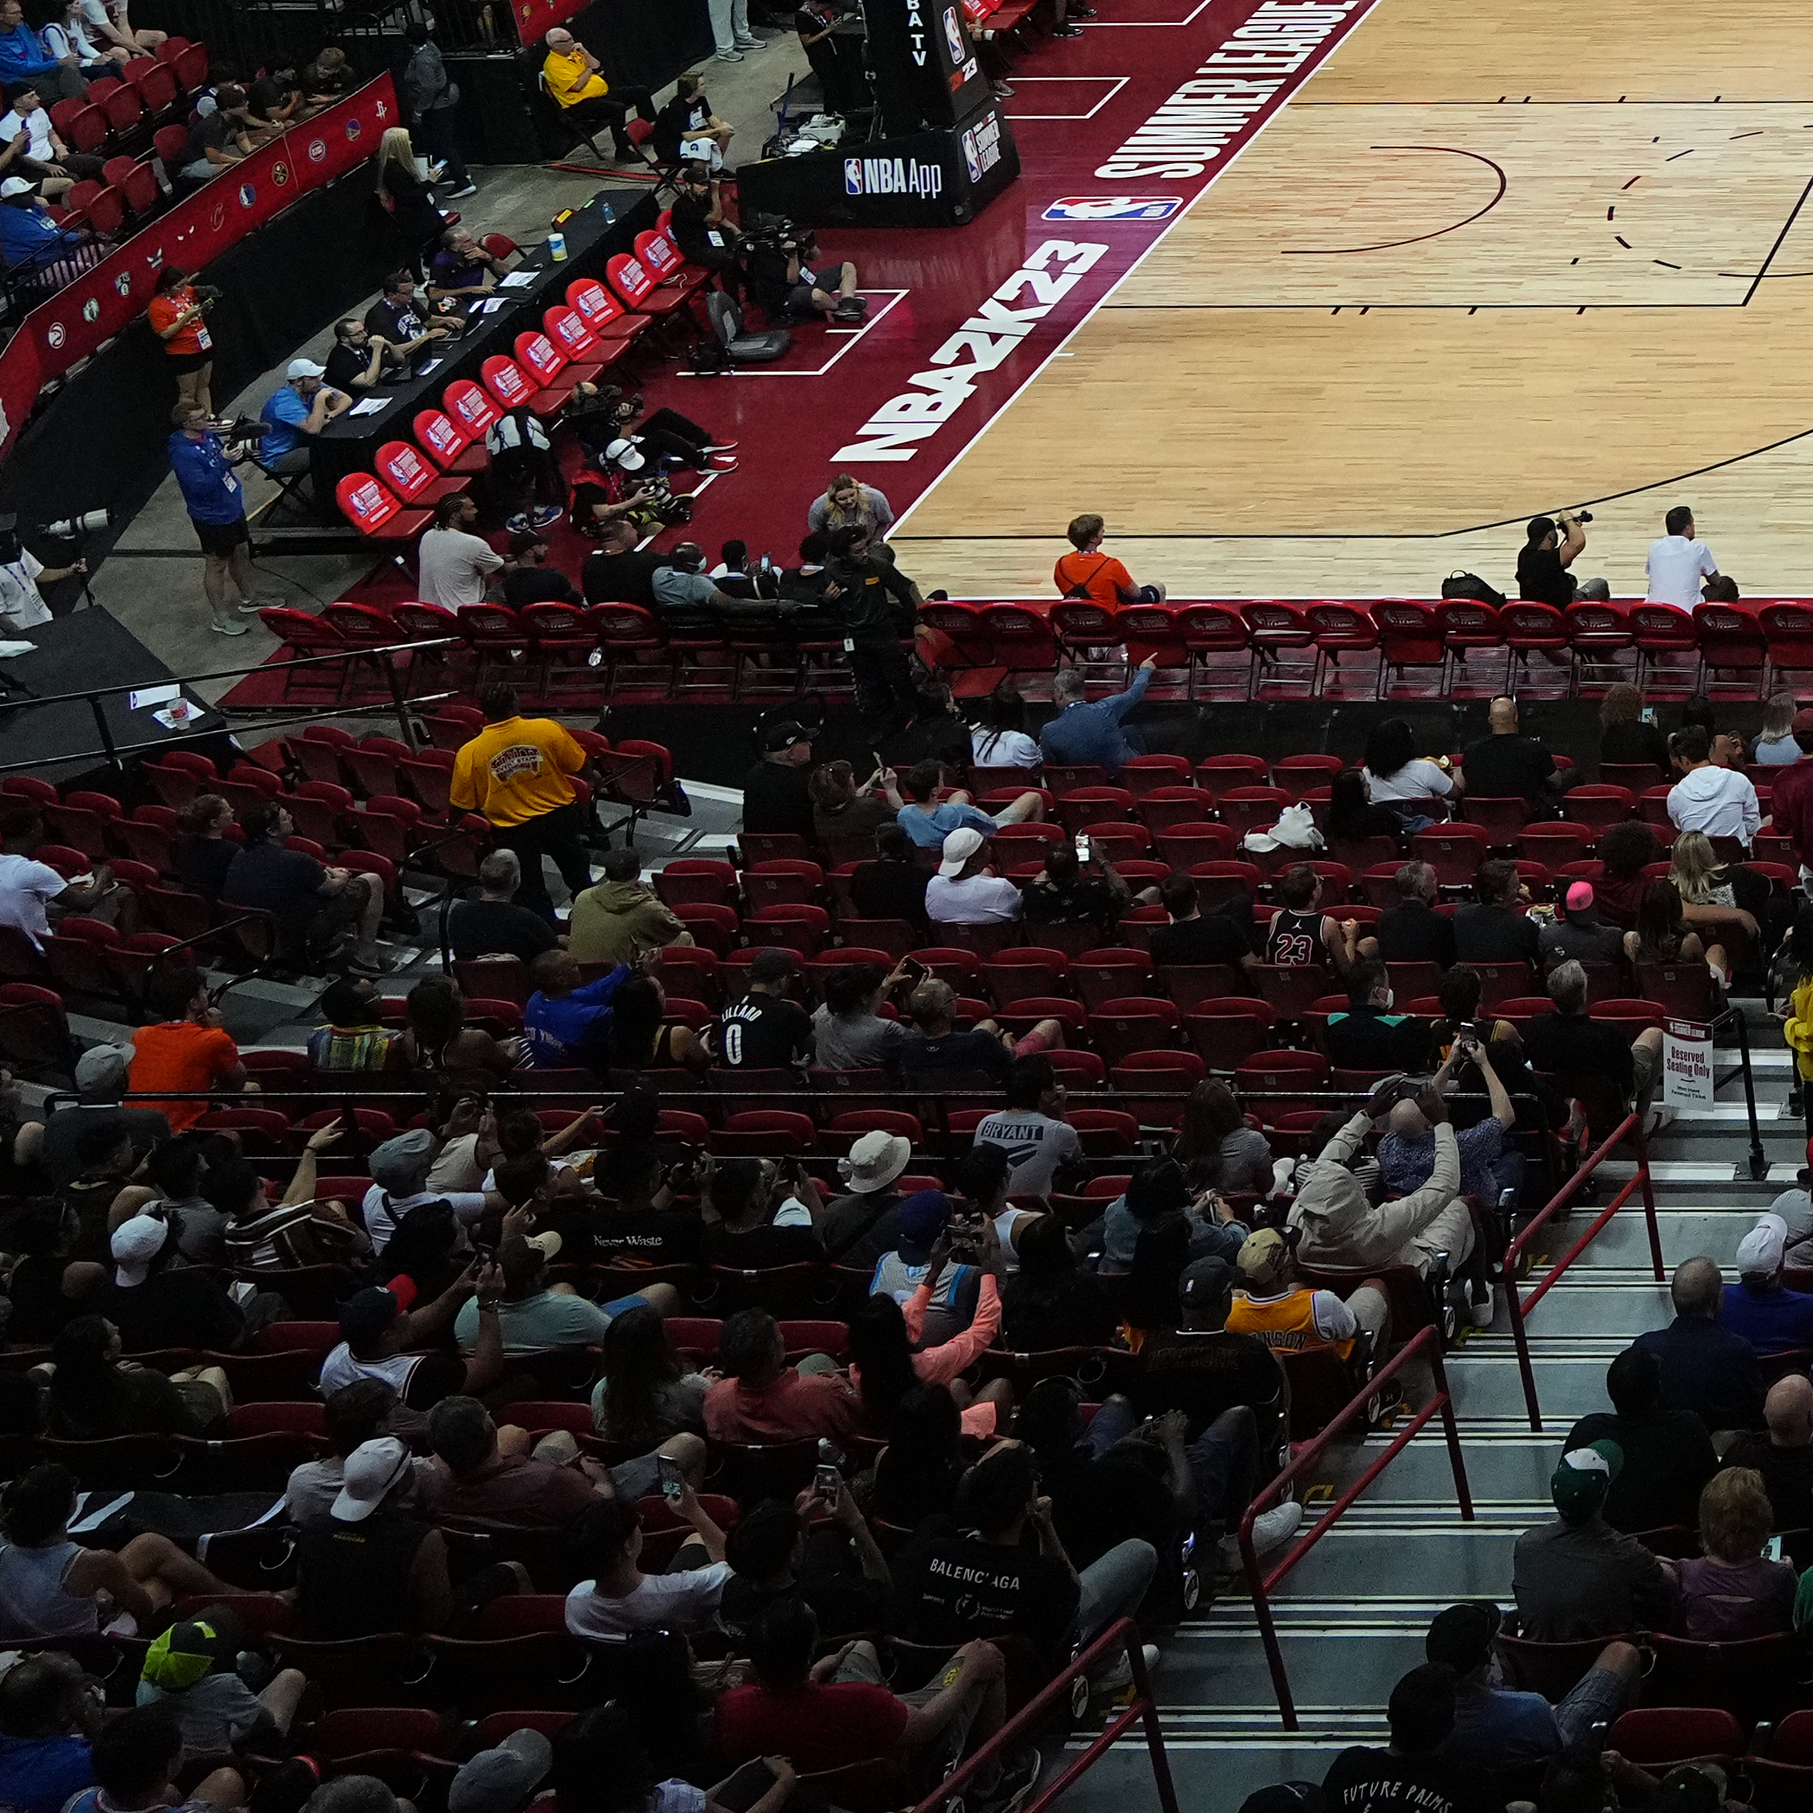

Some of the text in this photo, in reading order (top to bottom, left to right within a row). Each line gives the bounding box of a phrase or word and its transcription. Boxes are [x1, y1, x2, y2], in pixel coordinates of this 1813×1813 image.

[911, 35, 926, 67] TV
[1095, 0, 1358, 180] SUMMER LEAGUE
[975, 119, 1001, 154] SUMMER
[979, 140, 1002, 174] LEAGUE
[864, 157, 942, 199] NBA App
[830, 239, 1110, 462] NBA2K23
[1275, 933, 1310, 967] 23
[721, 1006, 763, 1024] LILLARD
[726, 1023, 742, 1065] 0
[1671, 1045, 1704, 1064] Reserved
[1667, 1058, 1710, 1080] Seating Only
[983, 1121, 1043, 1141] BRYANT
[593, 1233, 664, 1247] Never Waste
[1343, 1779, 1453, 1812] FUTURE PALMS
